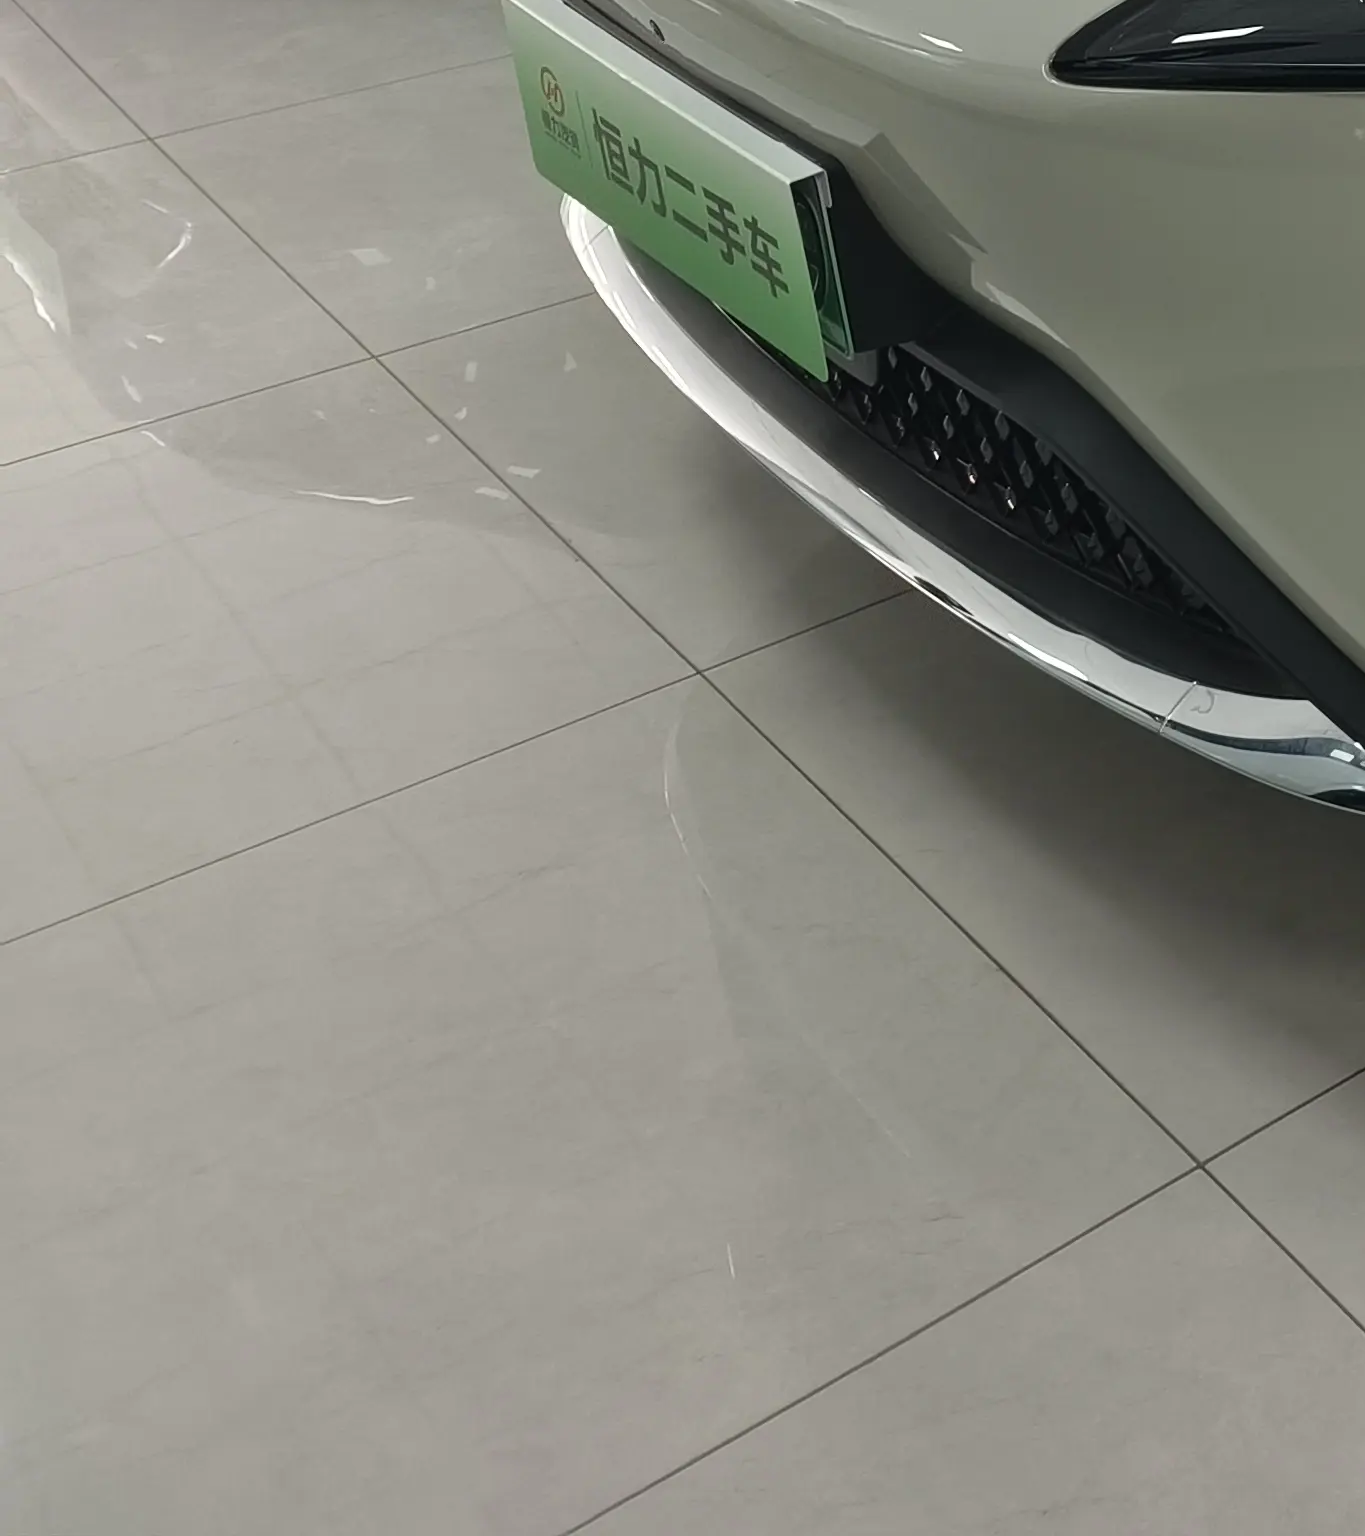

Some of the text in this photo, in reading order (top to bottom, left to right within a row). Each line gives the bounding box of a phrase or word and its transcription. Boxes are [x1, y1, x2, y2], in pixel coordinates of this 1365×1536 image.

[591, 107, 790, 299] 恒力二手车
